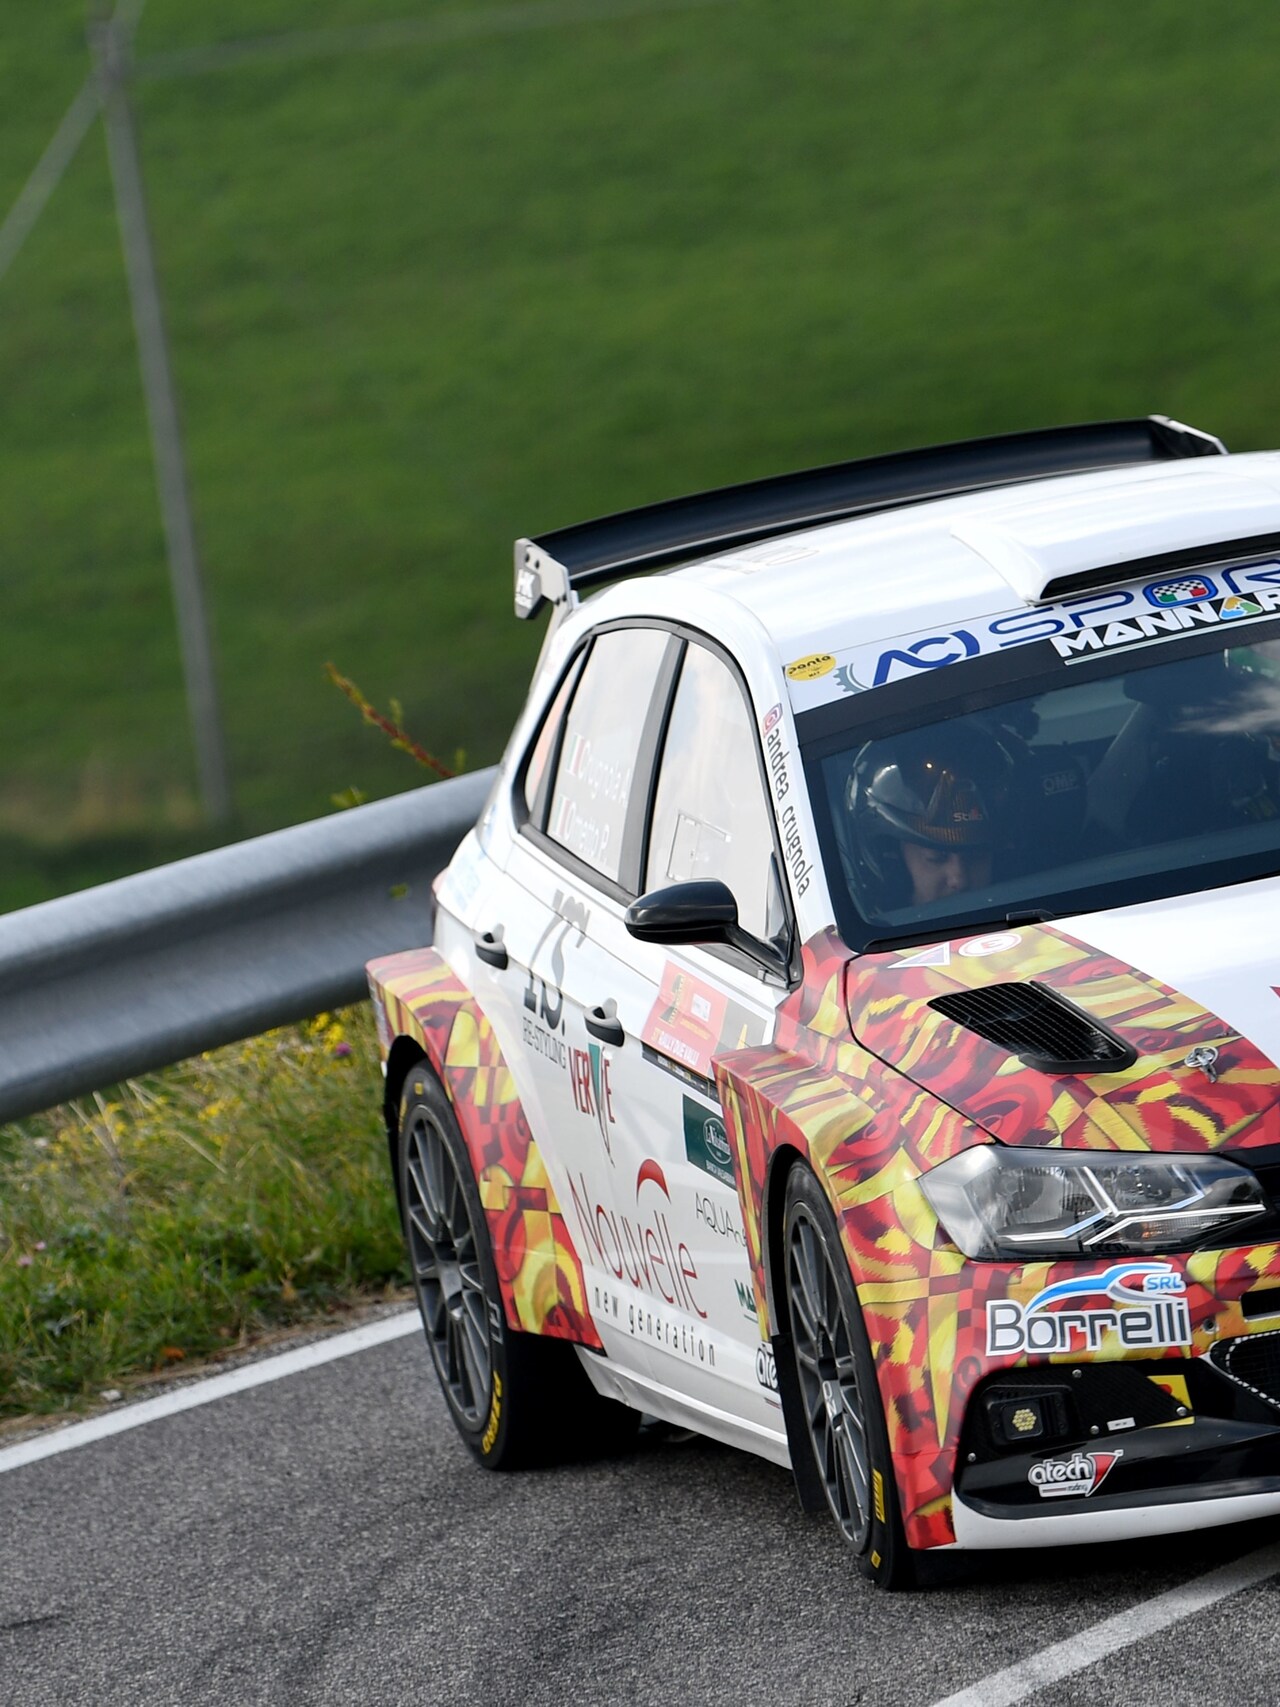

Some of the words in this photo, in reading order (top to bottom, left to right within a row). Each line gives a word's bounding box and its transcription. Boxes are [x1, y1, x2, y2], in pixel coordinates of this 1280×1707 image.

[566, 1166, 708, 1320] Nouvelle
[1146, 1275, 1183, 1291] SRL
[594, 1286, 620, 1319] new
[628, 1303, 716, 1367] generation
[989, 1302, 1188, 1351] Borrelli
[1031, 1455, 1091, 1485] atech
